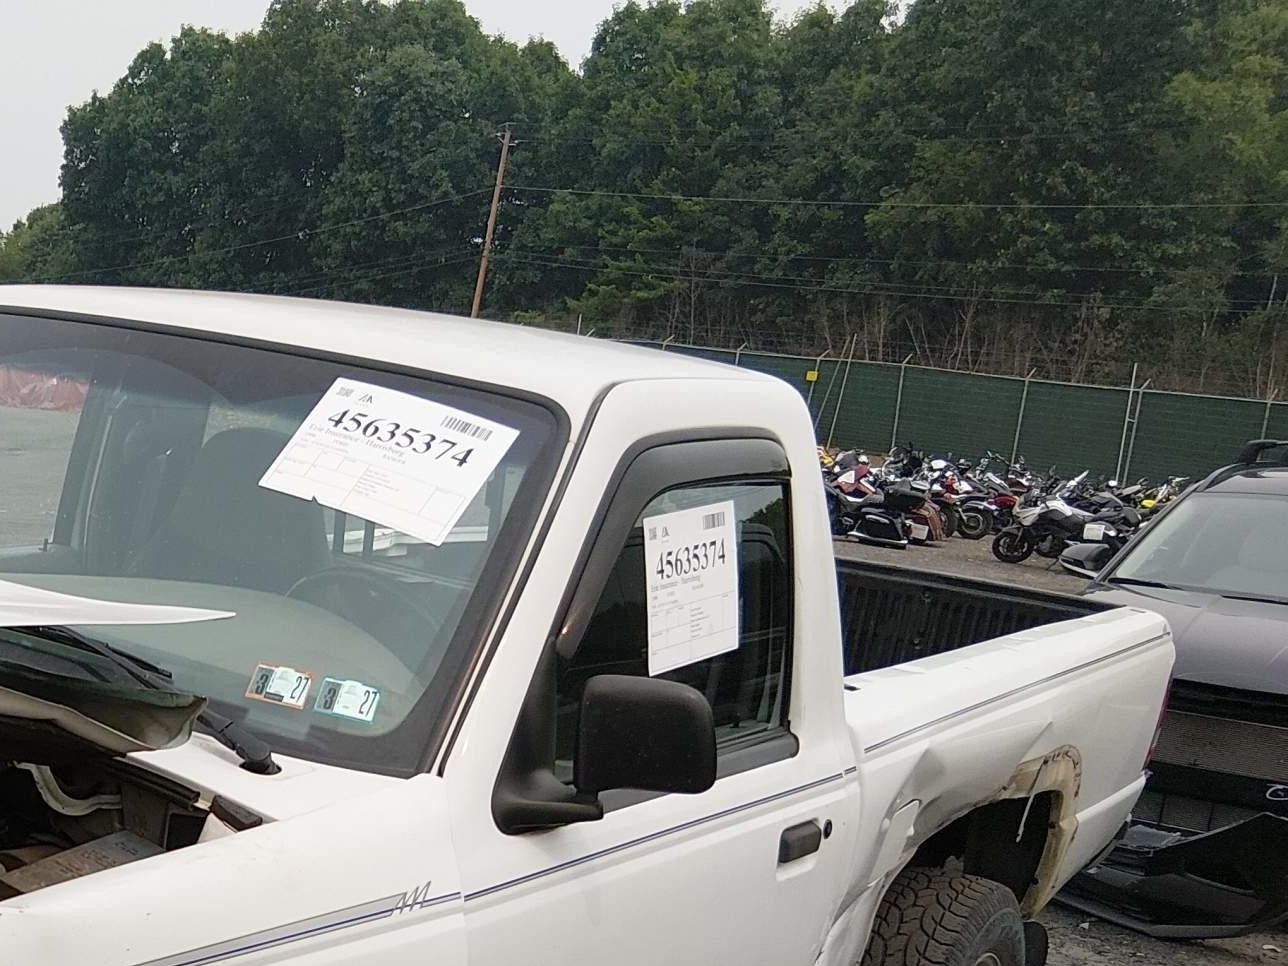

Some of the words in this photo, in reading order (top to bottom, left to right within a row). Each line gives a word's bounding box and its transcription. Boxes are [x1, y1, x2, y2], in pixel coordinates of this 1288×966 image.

[328, 409, 474, 467] 45635374
[656, 538, 726, 580] 45635374
[255, 673, 269, 695] 3
[290, 676, 309, 702] 27
[323, 687, 337, 710] 3
[358, 690, 377, 716] 27
